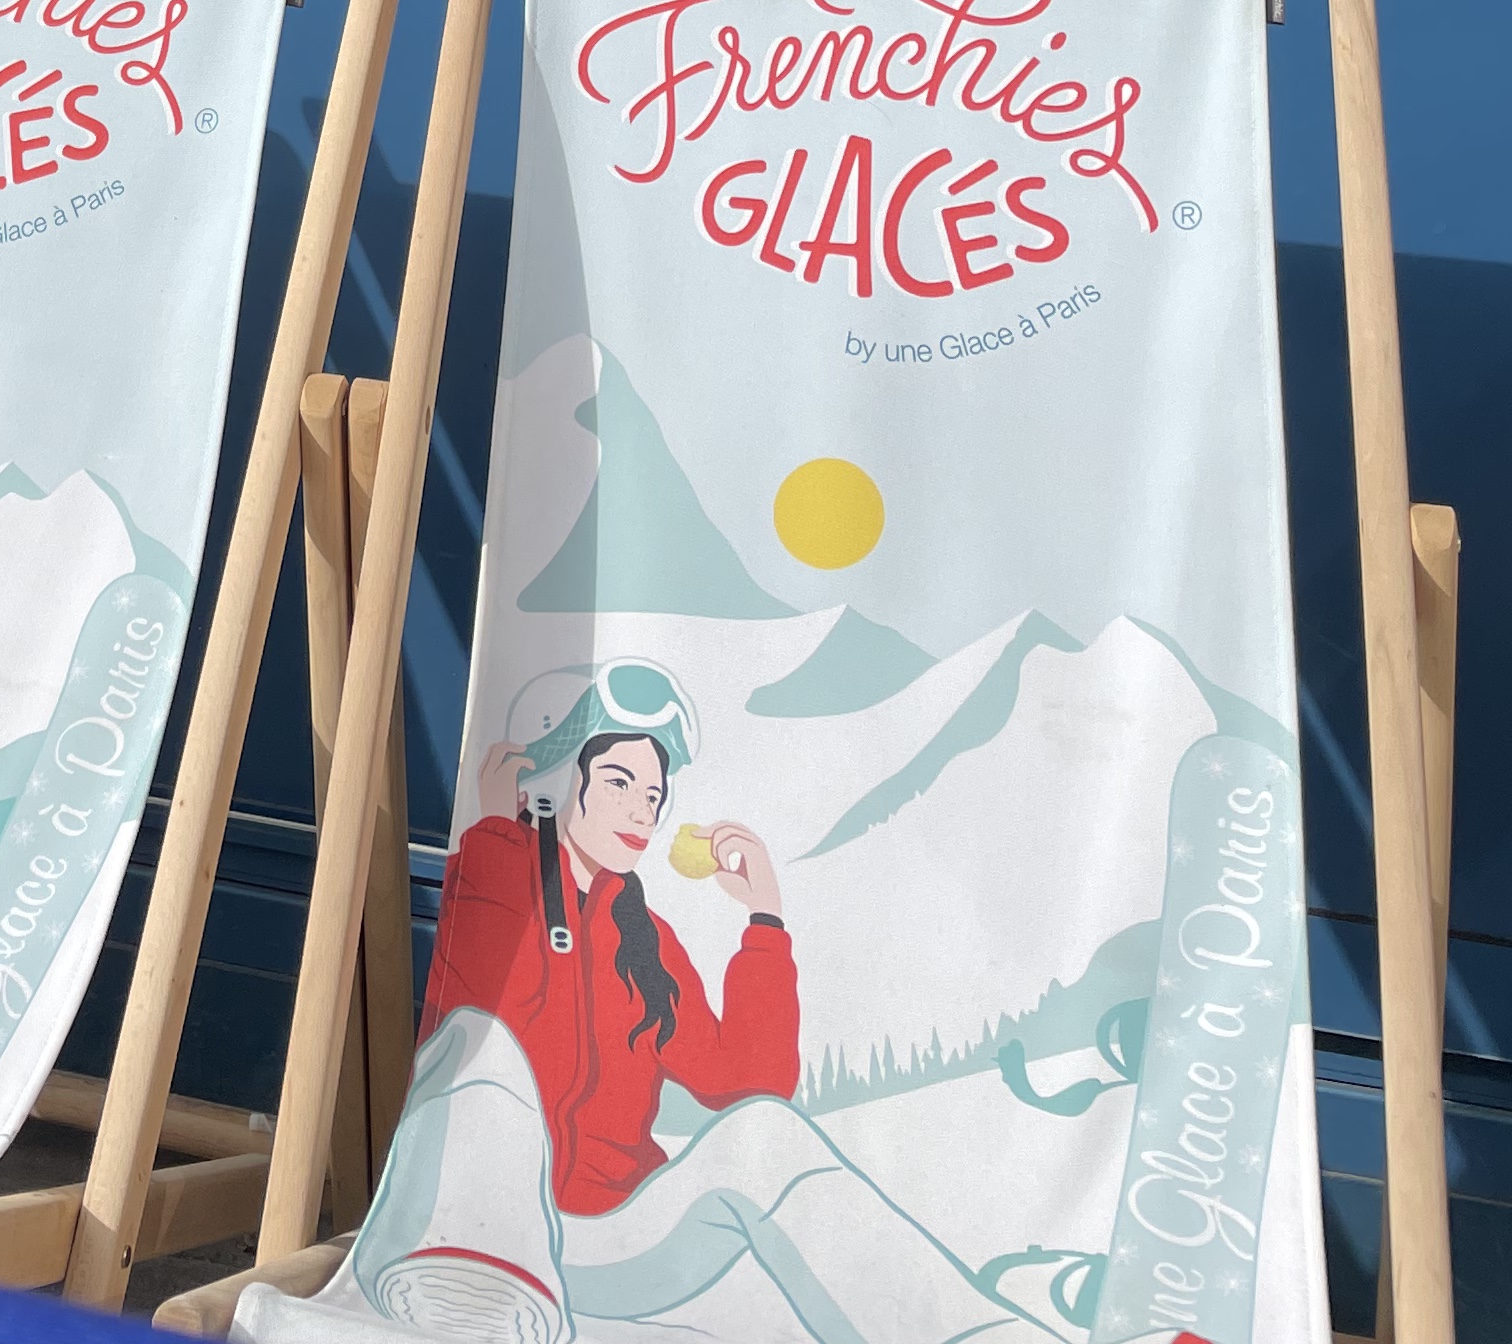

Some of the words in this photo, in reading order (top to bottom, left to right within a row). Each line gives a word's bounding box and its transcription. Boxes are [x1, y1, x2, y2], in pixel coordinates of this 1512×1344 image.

[54, 205, 68, 227] à
[70, 178, 126, 219] Paris
[693, 134, 1071, 300] GLACÉS
[844, 330, 877, 364] by
[885, 343, 934, 365] une
[939, 326, 1016, 362] Glace
[1019, 315, 1039, 340] à
[1037, 279, 1103, 329] Paris
[54, 616, 165, 778] Paris
[38, 803, 93, 838] à
[1176, 787, 1275, 970] Paris
[1180, 1002, 1245, 1038] à
[1127, 1063, 1257, 1262] Glace
